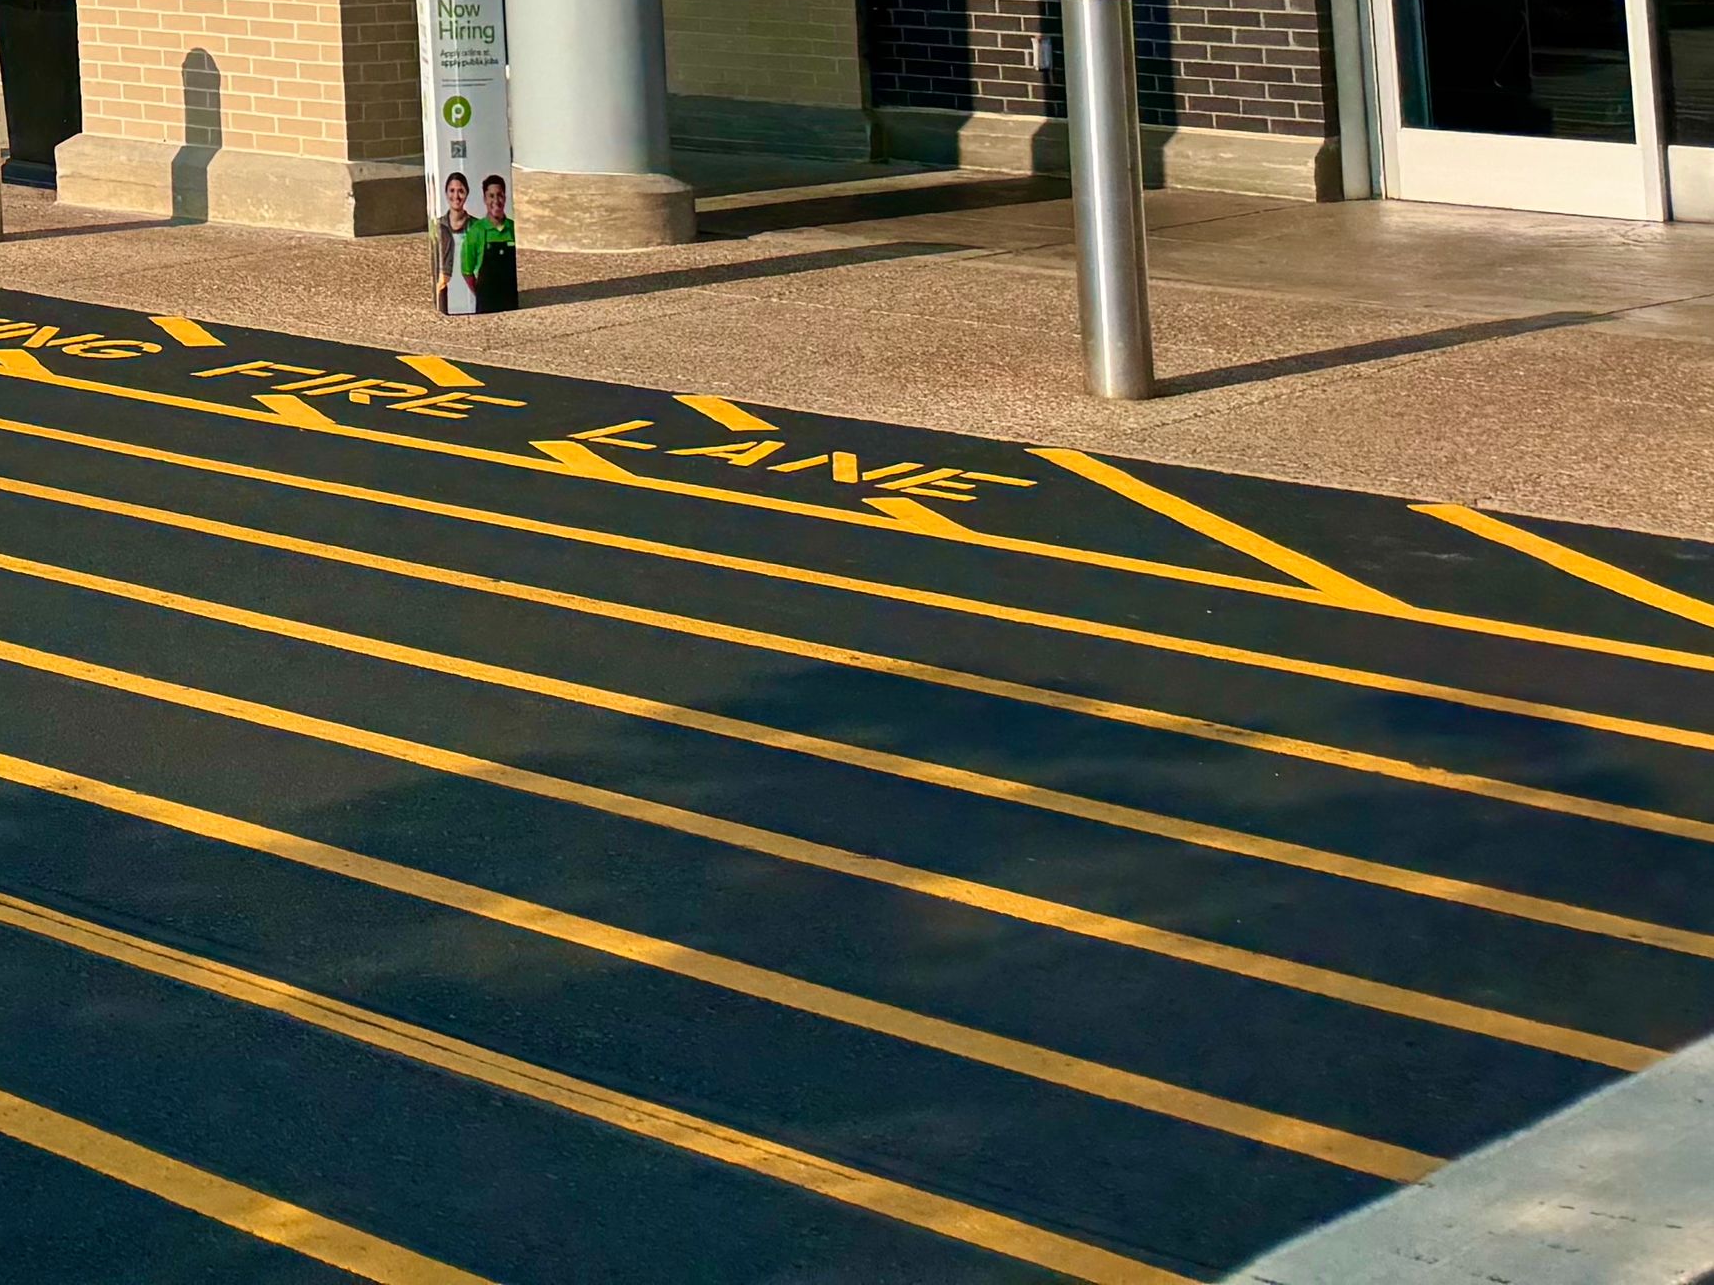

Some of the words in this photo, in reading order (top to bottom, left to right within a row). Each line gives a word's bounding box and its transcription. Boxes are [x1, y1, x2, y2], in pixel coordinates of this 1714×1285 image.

[438, 20, 495, 44] Hiring
[190, 360, 528, 419] FIRE
[569, 419, 1038, 501] LANE
